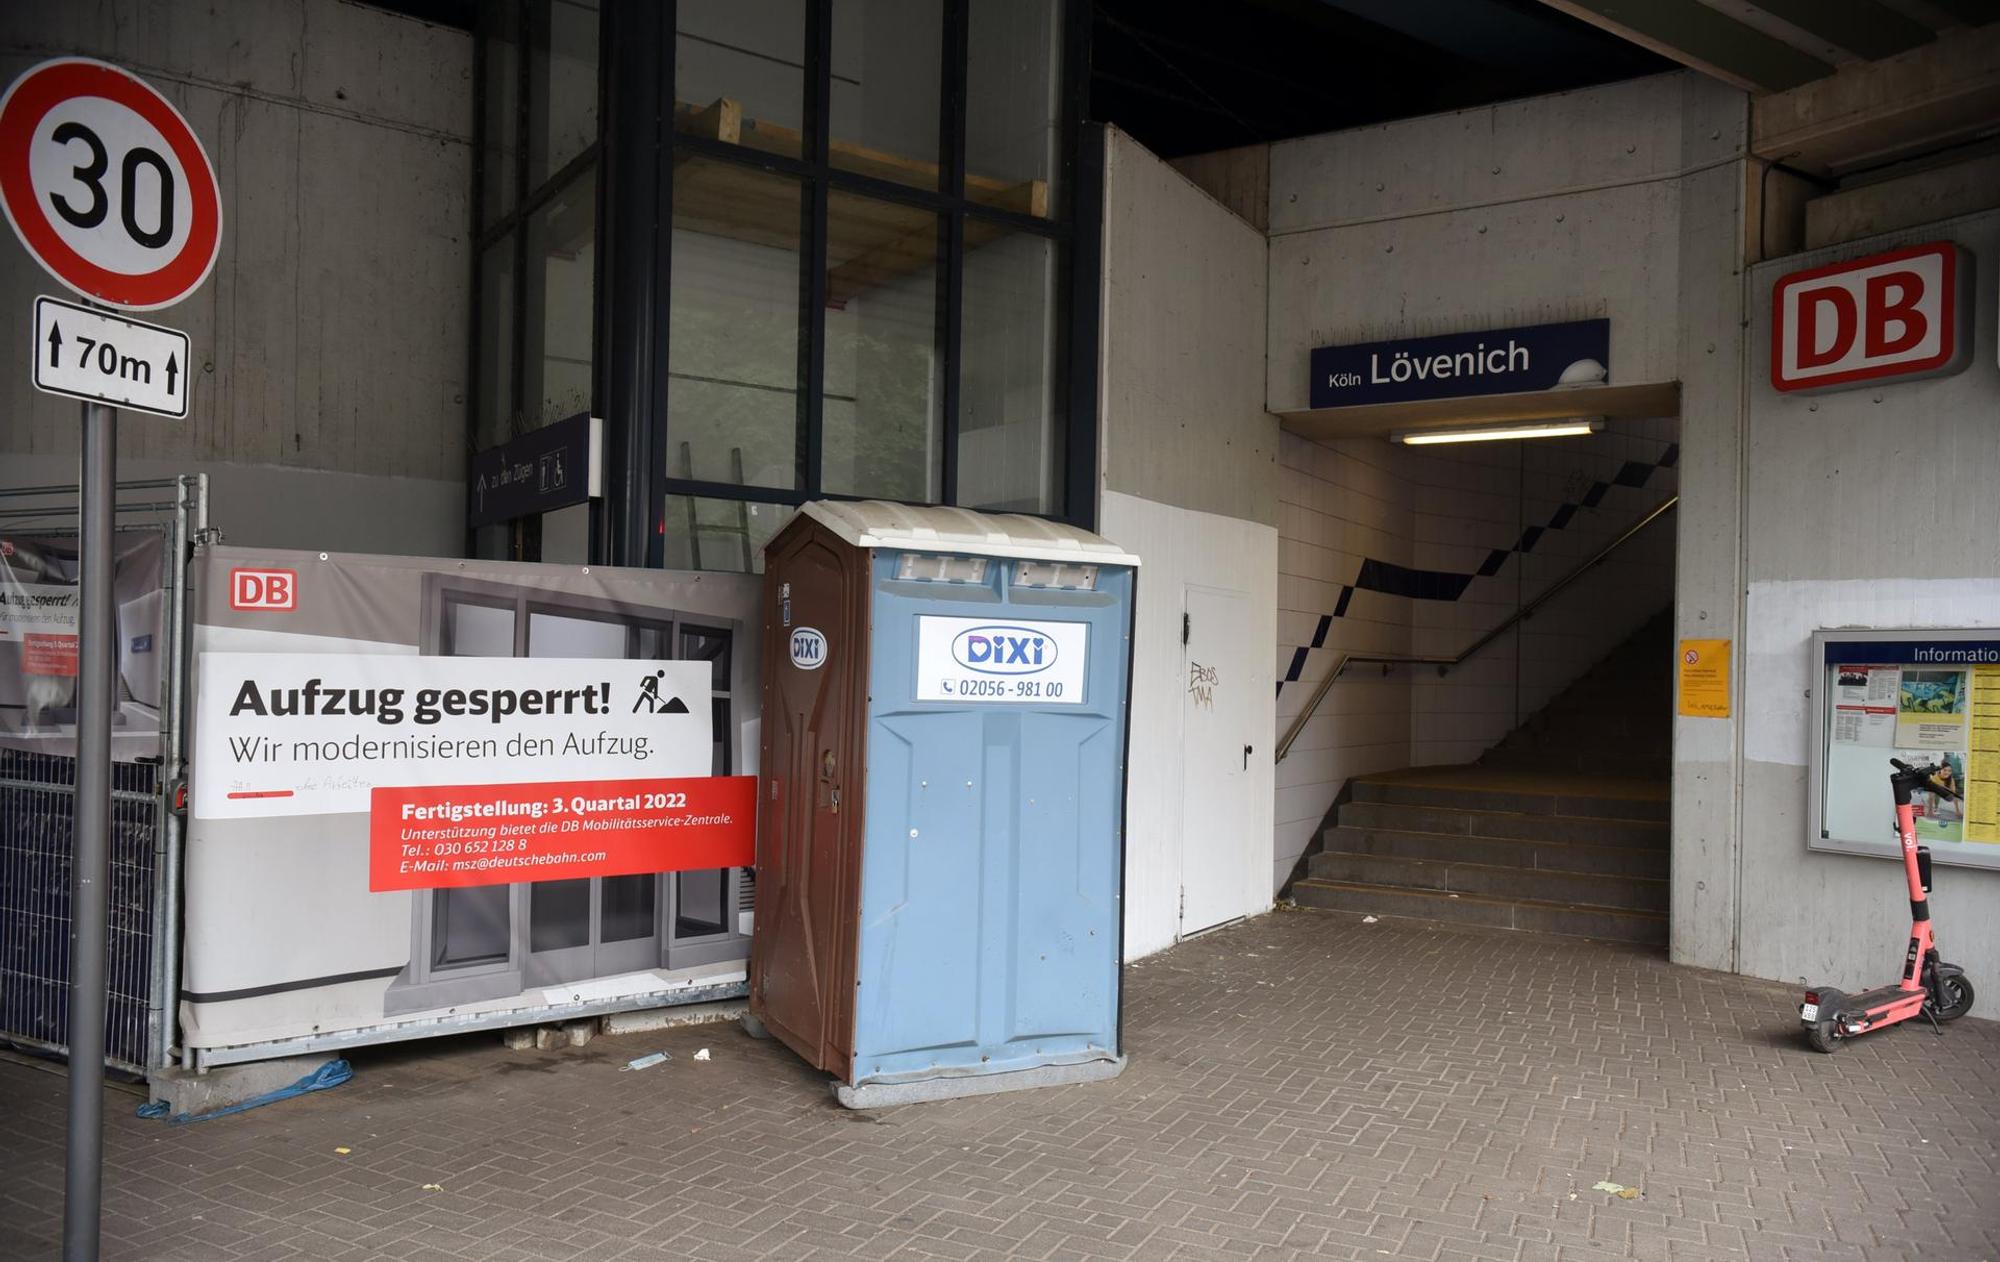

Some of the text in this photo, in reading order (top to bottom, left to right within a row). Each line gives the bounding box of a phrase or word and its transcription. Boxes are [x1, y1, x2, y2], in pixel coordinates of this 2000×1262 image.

[50, 122, 174, 248] 30
[1797, 271, 1927, 370] DB
[76, 336, 150, 384] 70m
[1328, 340, 1529, 388] Köln Lövenich
[238, 575, 289, 604] DB
[1914, 647, 1999, 663] Informatio
[229, 678, 610, 725] Aufzug gesperrt!
[960, 680, 1005, 696] 02056
[1017, 681, 1041, 697] 981
[1046, 682, 1063, 698] 00
[229, 731, 654, 763] Wir modernisieren den Aufzug.
[401, 792, 687, 822] Fertigstellung: 3. Quartal 2022
[401, 812, 733, 841] Unterstützung bietet die DB Mobilitätsservice-Zentrale.
[400, 851, 606, 873] E-Mail: msz@deutschebahn.com
[402, 838, 527, 857] Tel.: 030 652 128 8
